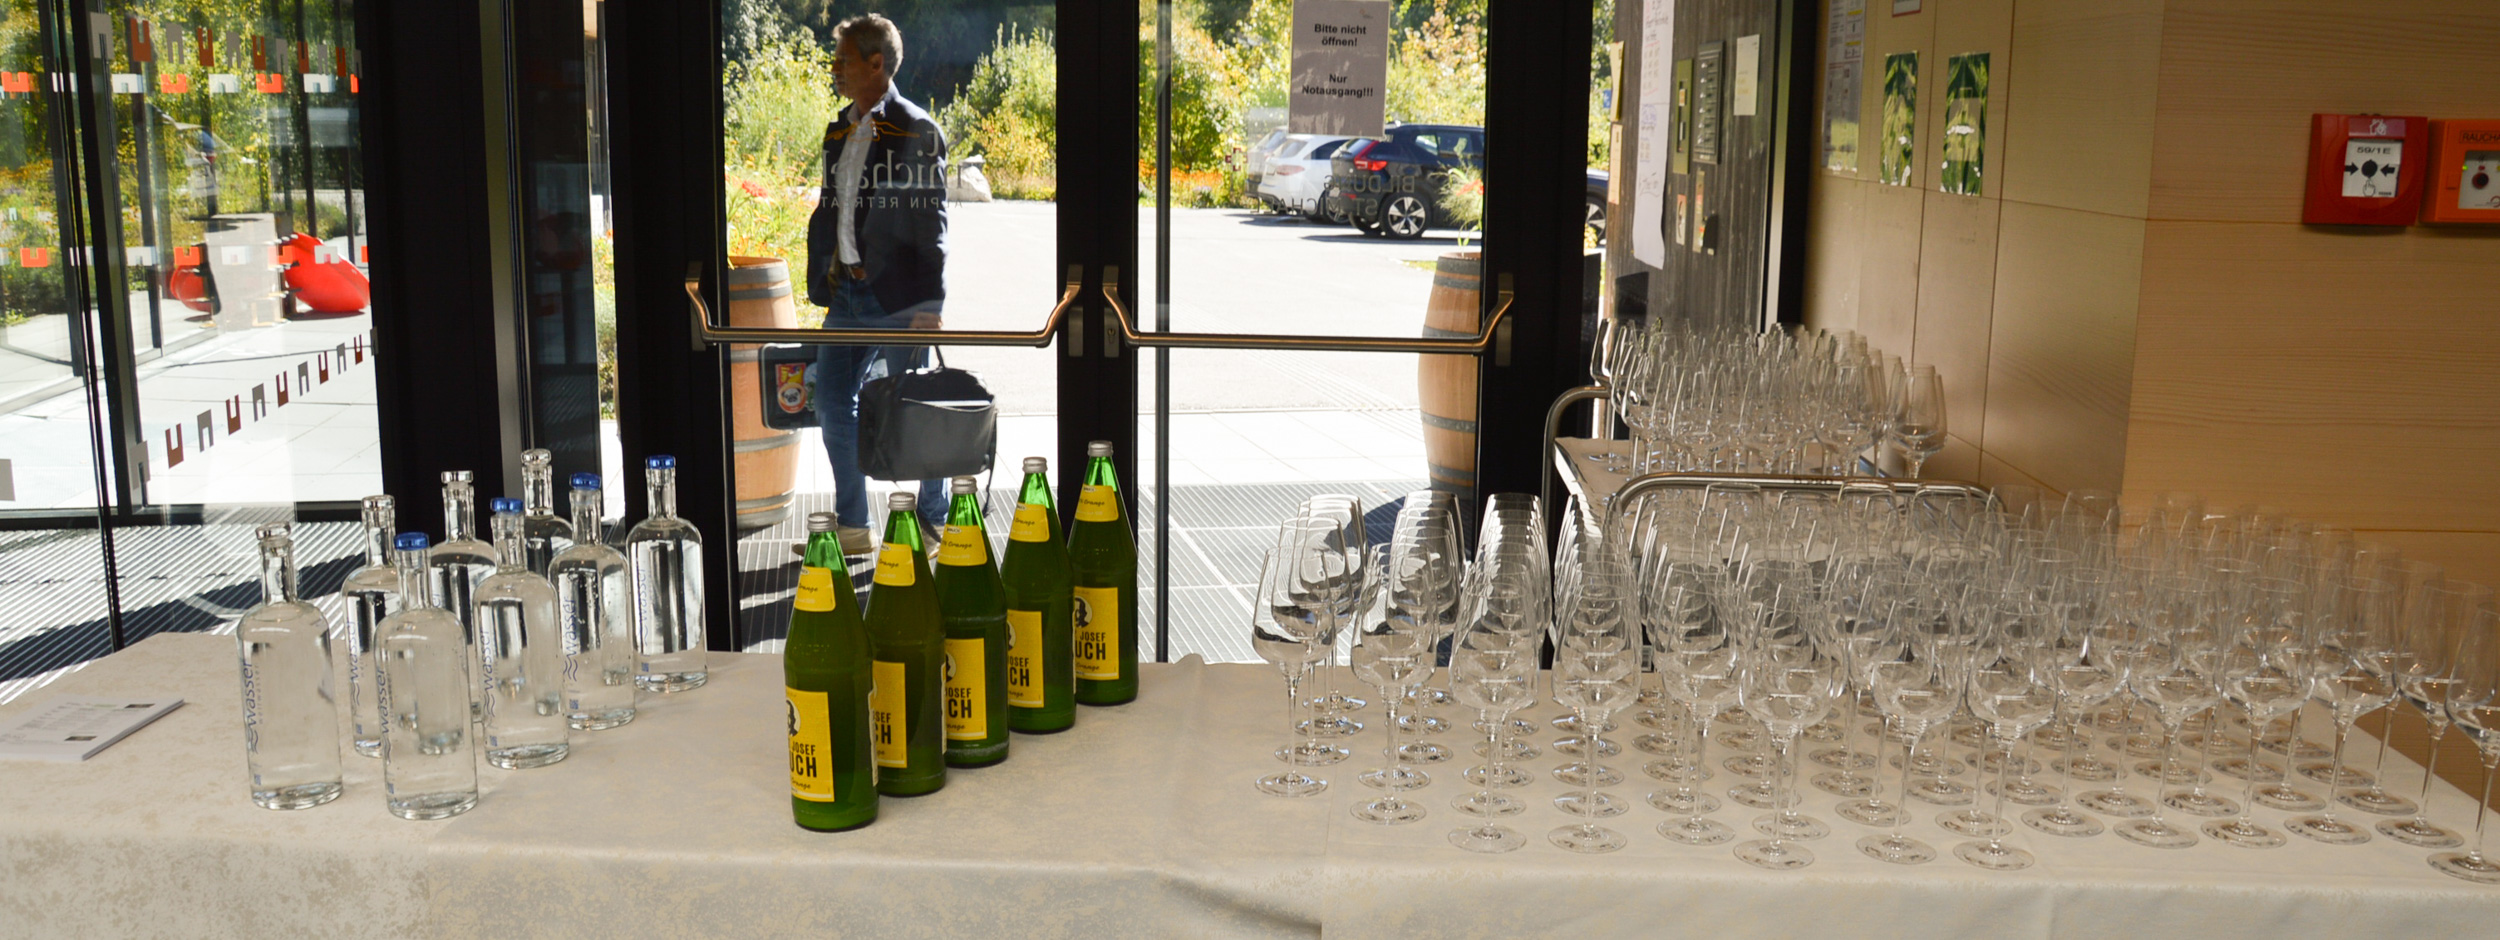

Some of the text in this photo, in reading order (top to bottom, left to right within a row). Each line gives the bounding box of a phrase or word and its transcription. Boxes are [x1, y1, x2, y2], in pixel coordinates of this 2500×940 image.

[1314, 23, 1367, 35] Bitte nicht
[1321, 36, 1358, 47] öffnen!
[1328, 73, 1348, 84] Nur
[1301, 85, 1374, 99] Notausgang!!!
[562, 596, 577, 657] wasser
[1080, 631, 1106, 642] JOSEF
[480, 630, 494, 691] wasser
[1008, 656, 1029, 668] OSEF
[243, 659, 257, 727] wasser
[376, 667, 389, 734] wasser
[792, 741, 816, 756] JOSEF
